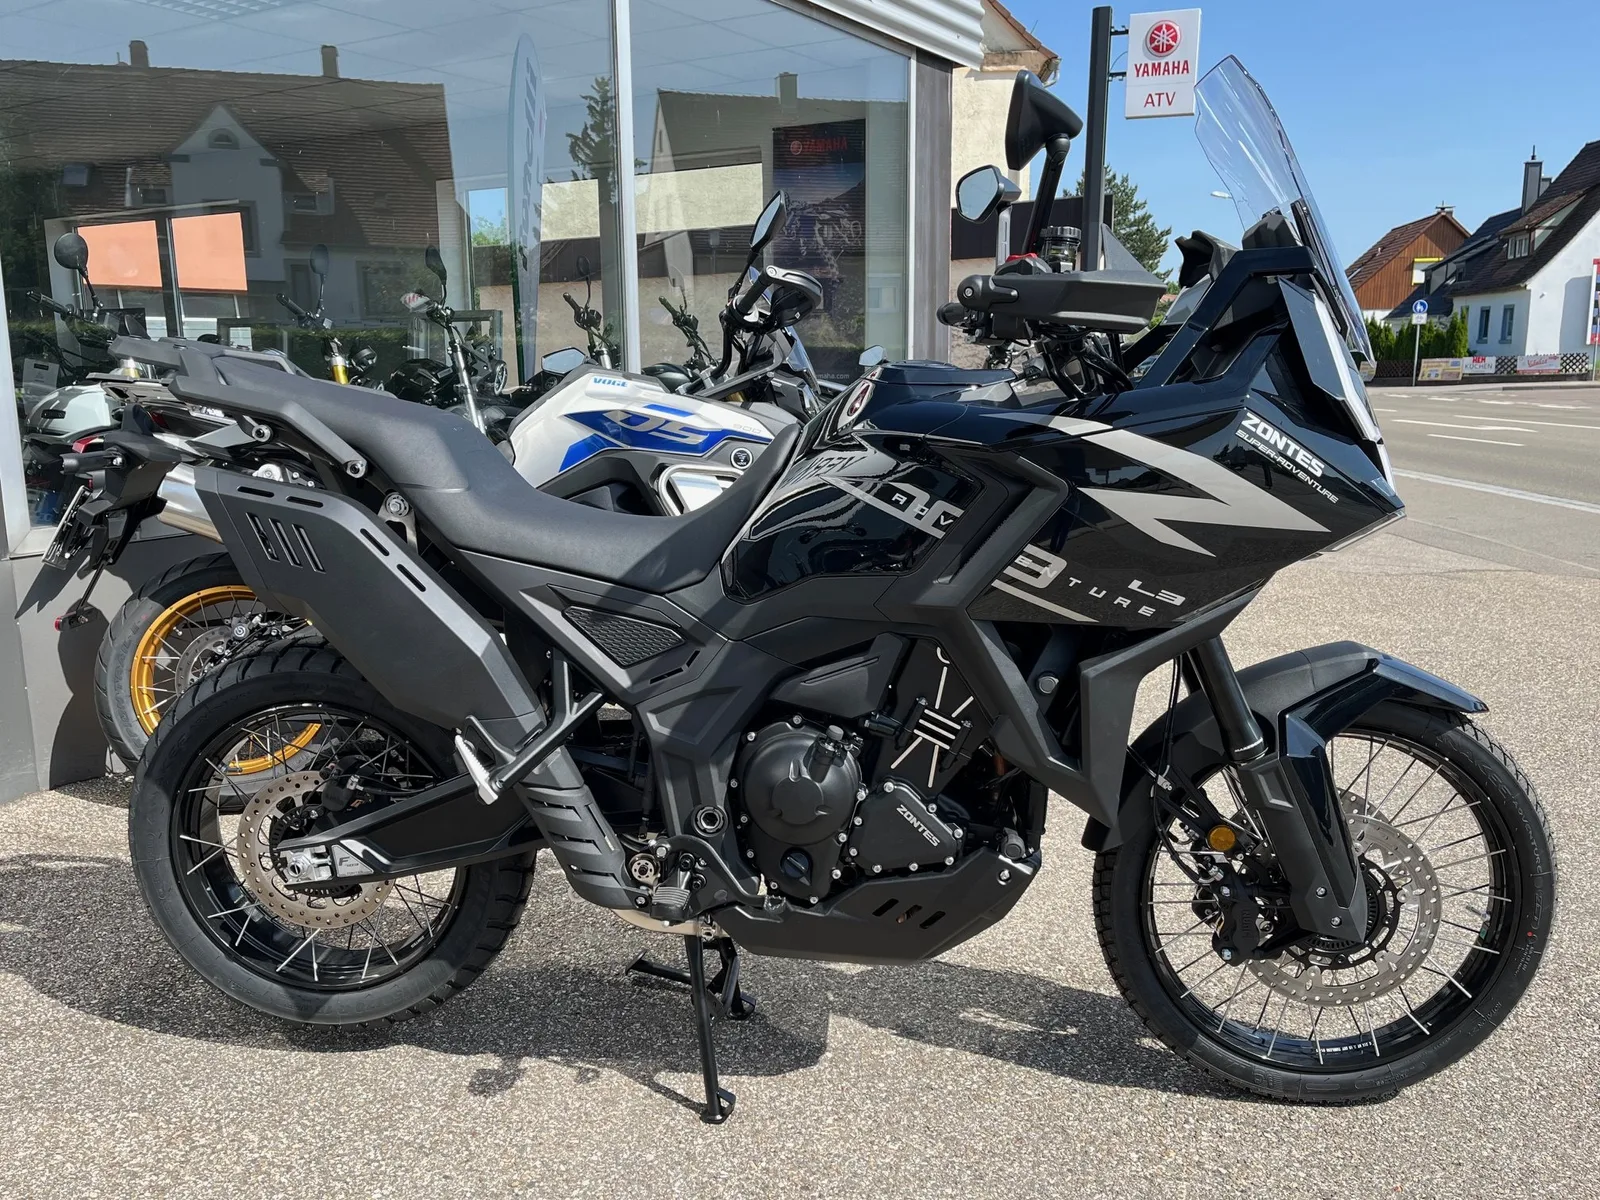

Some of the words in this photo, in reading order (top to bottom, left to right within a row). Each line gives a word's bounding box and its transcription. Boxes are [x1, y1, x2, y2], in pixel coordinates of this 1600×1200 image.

[1134, 60, 1190, 78] YAMAHA
[1143, 91, 1176, 108] ATV
[802, 137, 848, 152] YAMAHA
[592, 376, 628, 388] VOGE
[602, 410, 710, 445] DS
[1241, 412, 1325, 478] ZONTES
[1235, 429, 1339, 504] SUPER-ADVENTURE
[1128, 579, 1186, 606] L3
[896, 804, 941, 847] ZONTES
